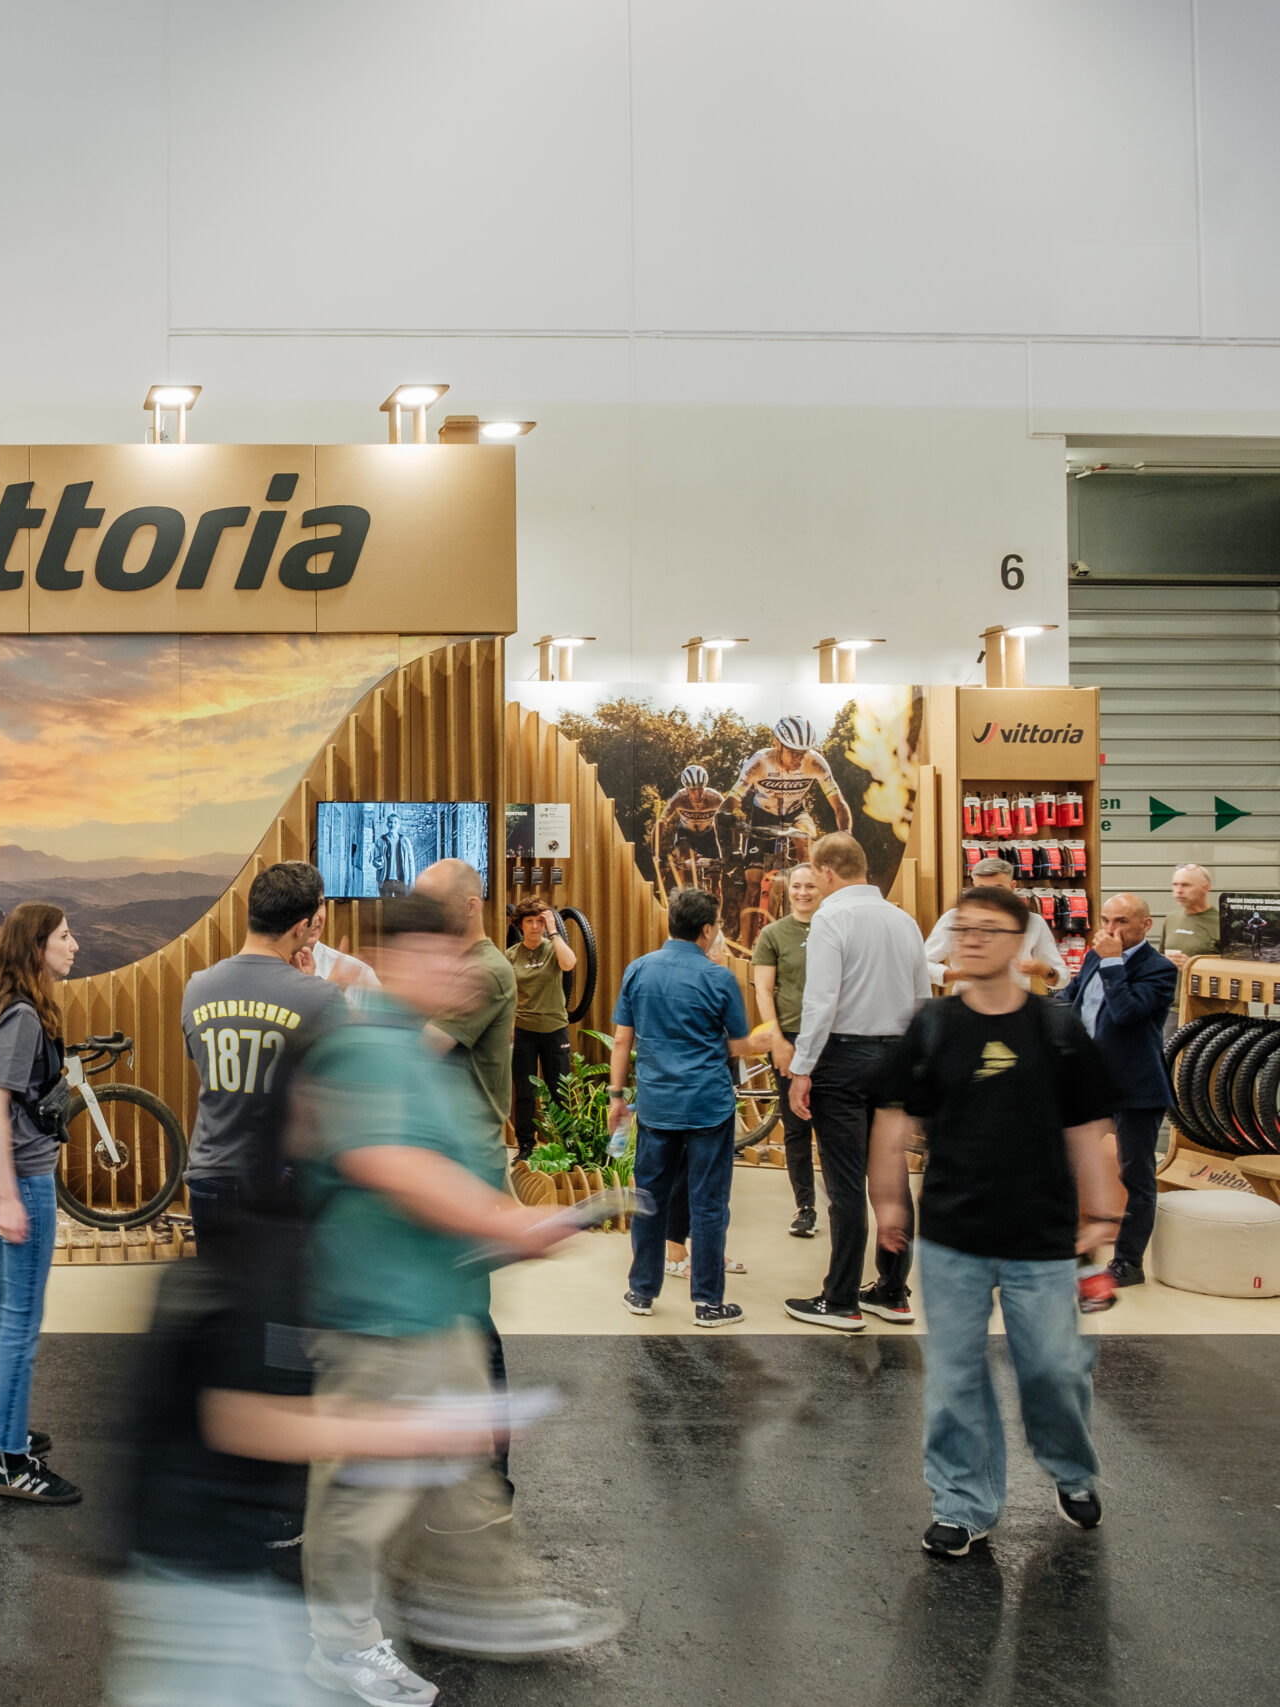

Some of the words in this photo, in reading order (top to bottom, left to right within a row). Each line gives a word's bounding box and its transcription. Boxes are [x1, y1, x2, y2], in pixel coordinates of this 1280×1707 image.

[1000, 553, 1025, 590] 6
[1000, 722, 1084, 744] vittoria
[192, 1000, 301, 1030] ESTABLISHED
[200, 1027, 286, 1094] 1872
